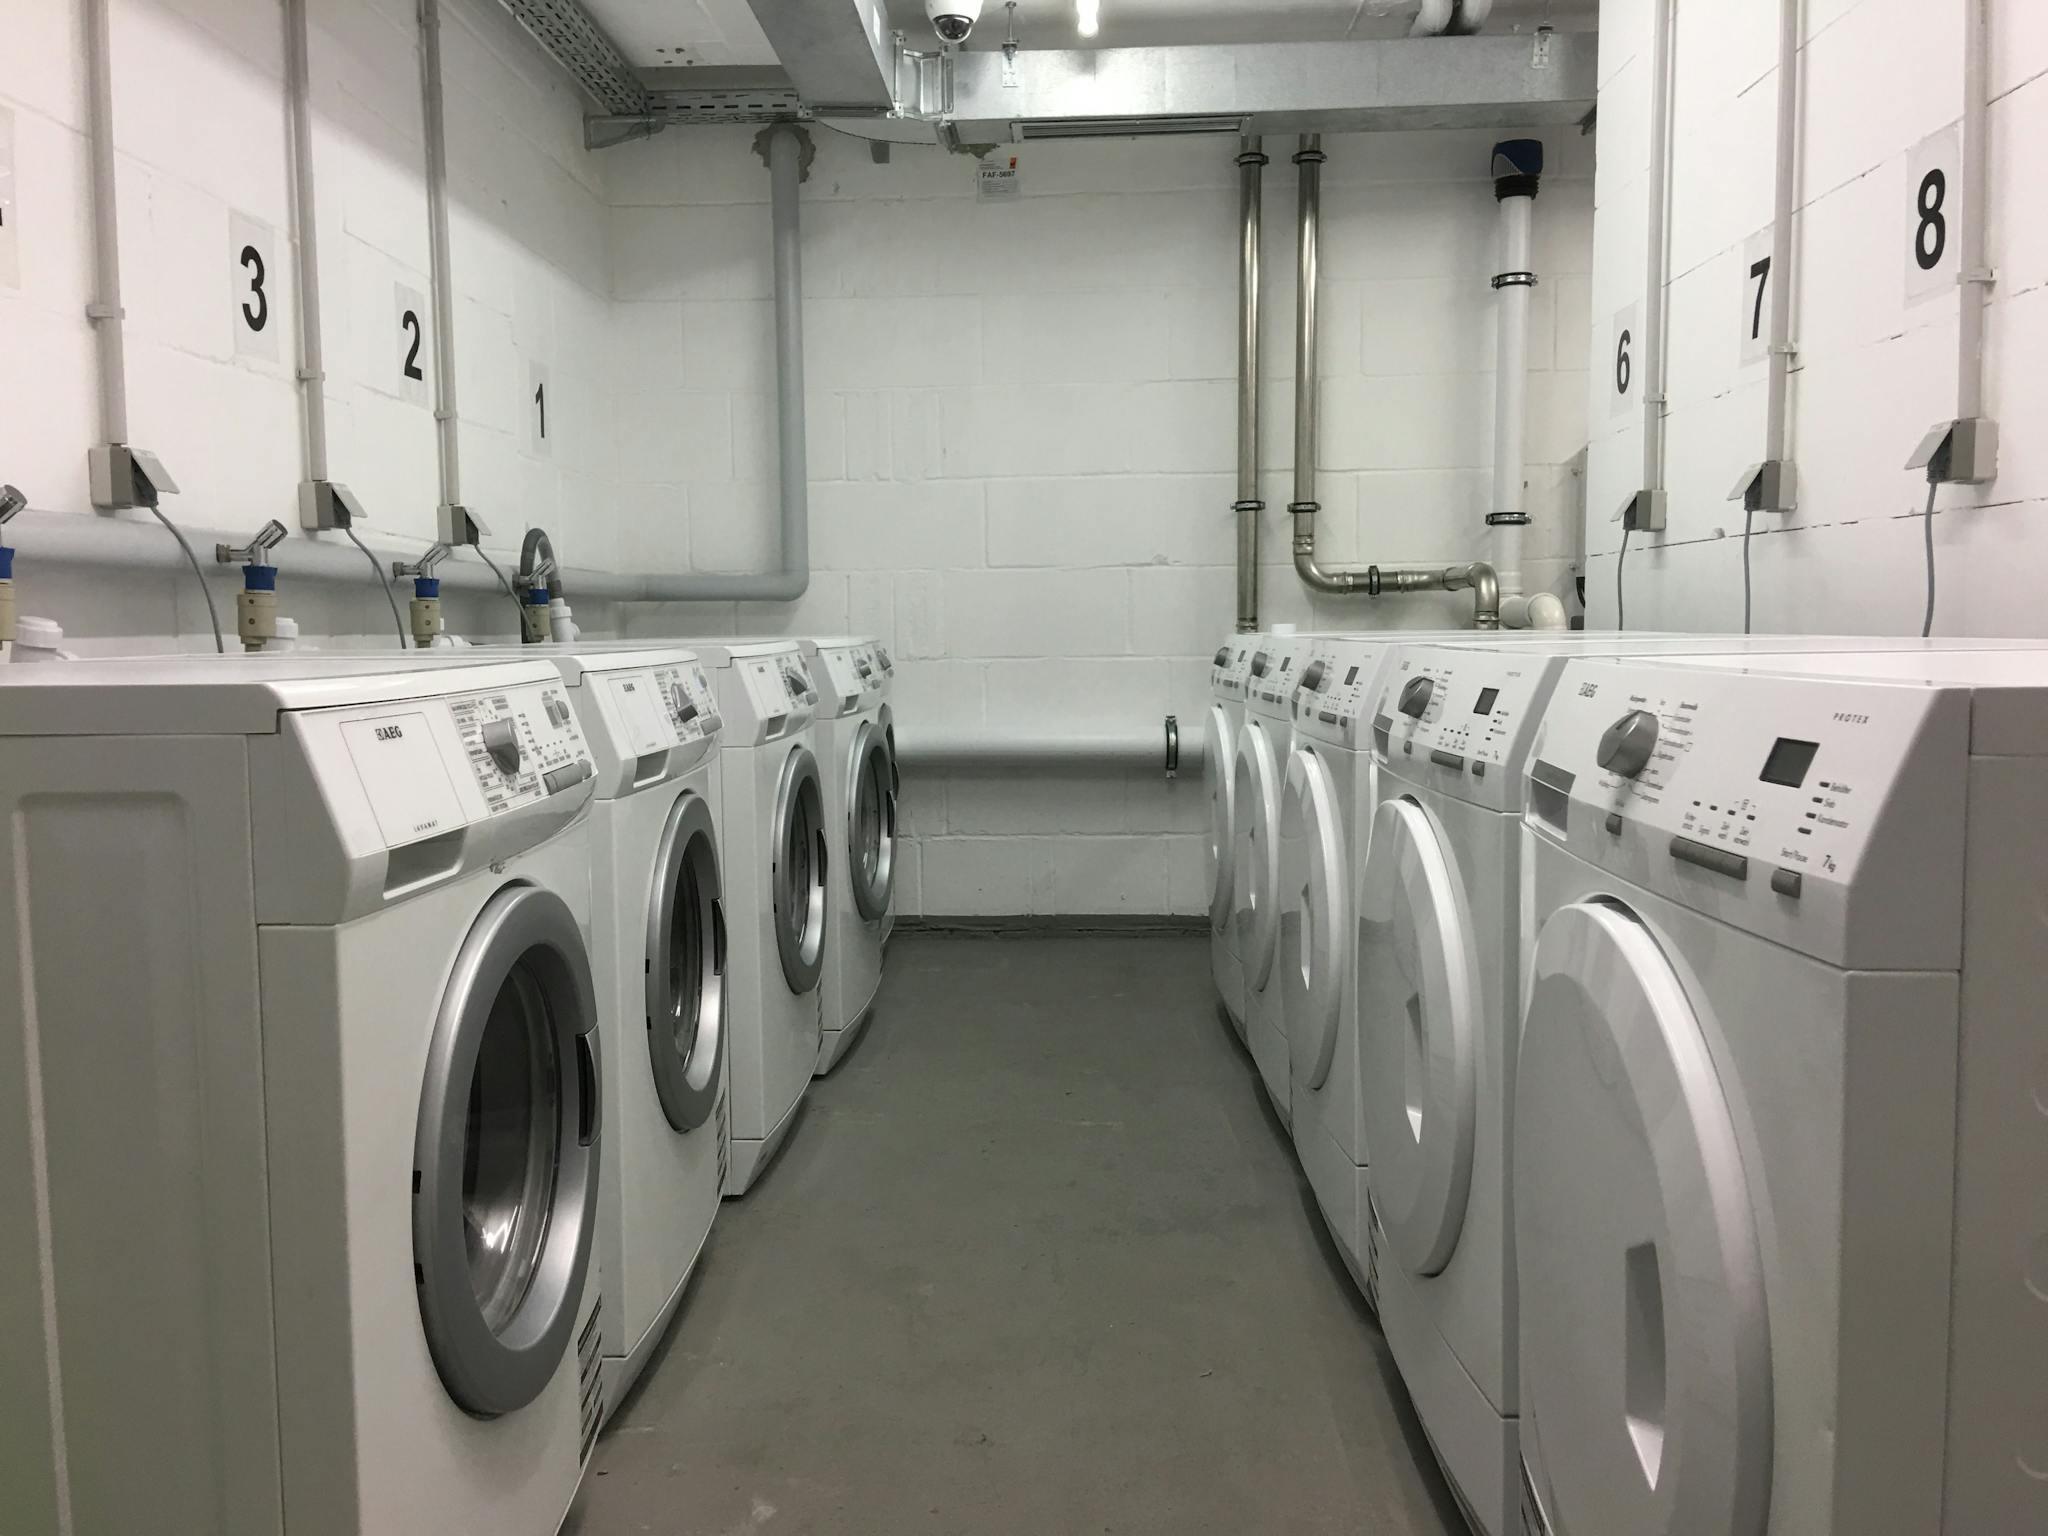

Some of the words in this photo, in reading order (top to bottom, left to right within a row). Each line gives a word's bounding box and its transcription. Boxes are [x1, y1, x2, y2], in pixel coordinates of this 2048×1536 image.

[1915, 168, 1946, 270] 8
[240, 245, 268, 332] 3
[1750, 255, 1771, 340] 7
[402, 310, 423, 382] 2
[1616, 329, 1631, 395] 6
[534, 383, 545, 439] 1
[382, 725, 403, 740] AEG
[1832, 712, 1870, 725] PROTEX
